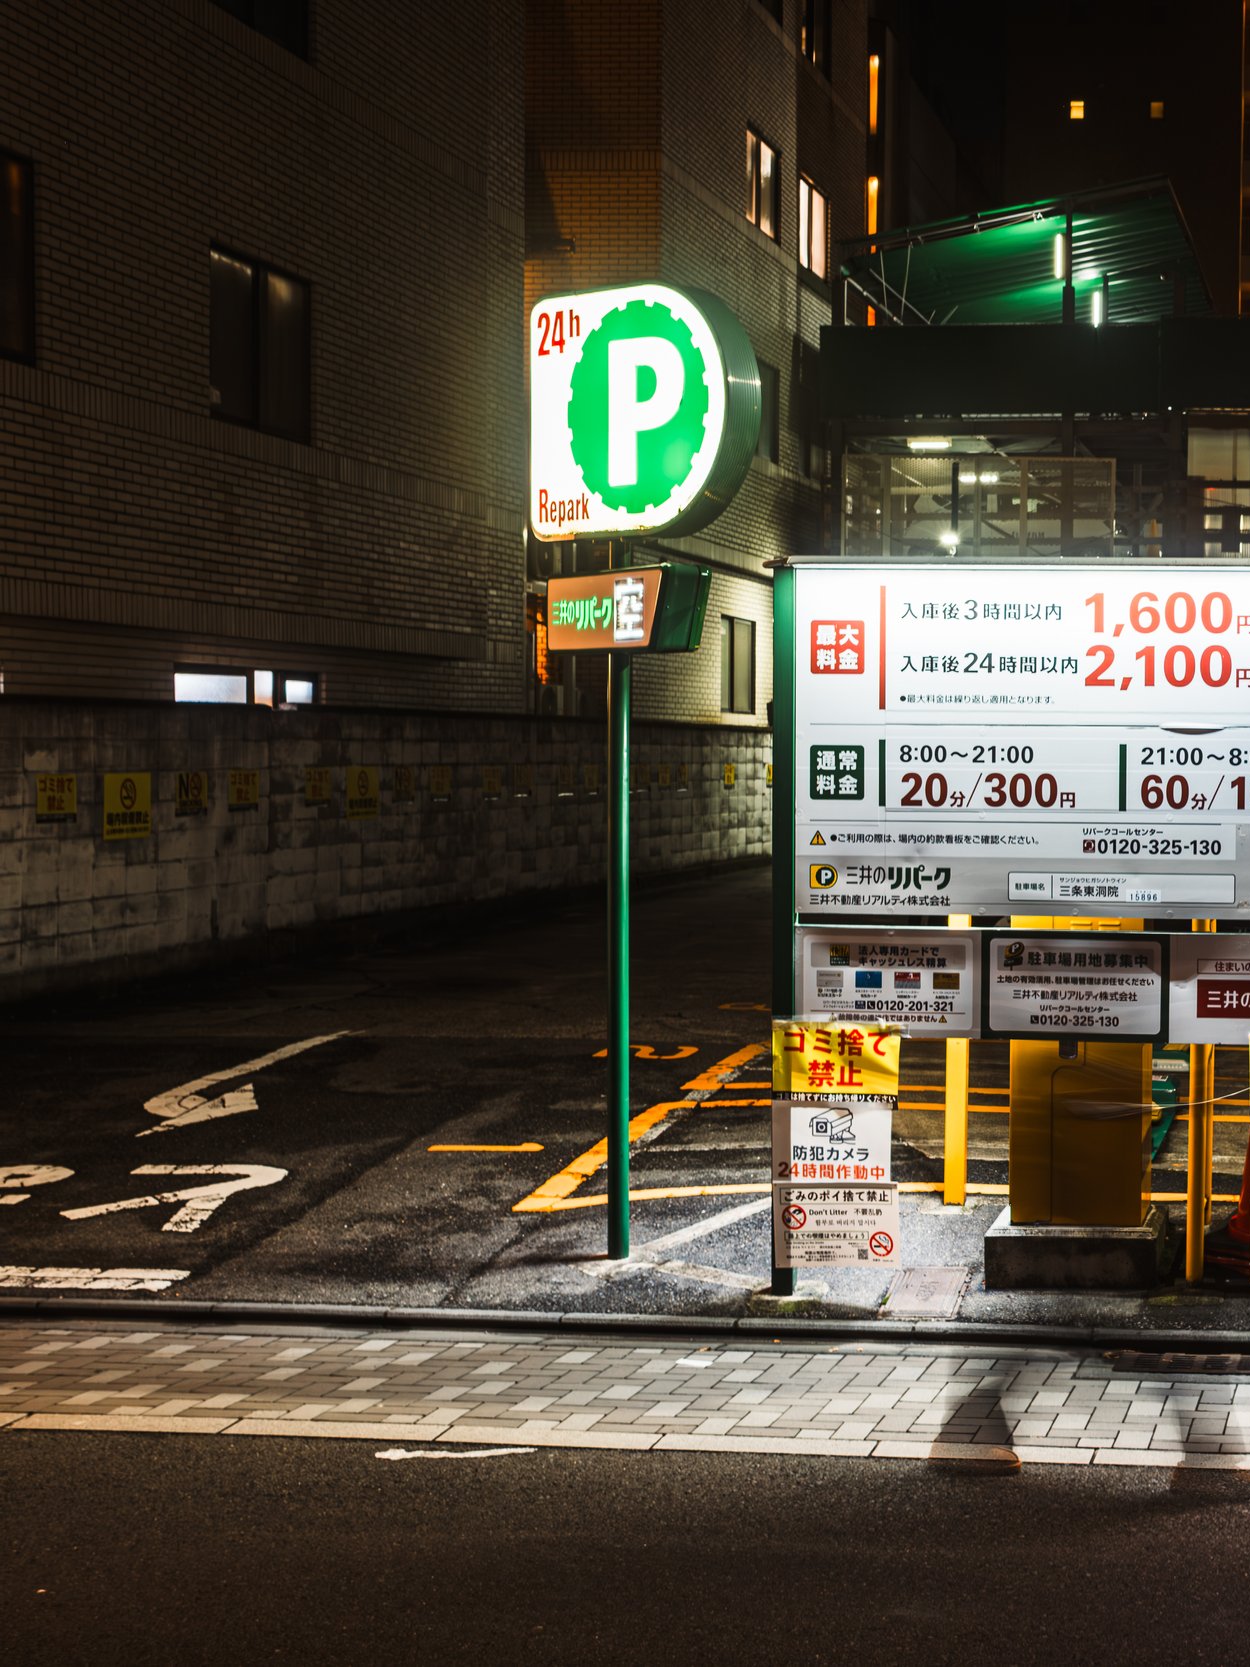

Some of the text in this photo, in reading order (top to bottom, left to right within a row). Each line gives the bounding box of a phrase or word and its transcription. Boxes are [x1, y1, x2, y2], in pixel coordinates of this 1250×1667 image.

[537, 309, 581, 356] 24h
[607, 336, 685, 488] P
[538, 488, 590, 528] Repark
[551, 597, 613, 629] 三井のリパーク
[900, 599, 1063, 621] 入庫後3時間以内
[816, 624, 860, 647] 最大
[816, 648, 860, 671] 料金
[900, 652, 1079, 675] 入庫後24時間以内
[815, 750, 859, 771] 通常
[815, 774, 859, 796] 料金
[1082, 827, 1164, 836] リパークコールセンター
[1097, 839, 1222, 856] 0120-325-130
[845, 863, 952, 891] 三井のリパーク
[1014, 882, 1046, 892] 駐車場名
[1058, 884, 1120, 899] 三条東洞院
[809, 893, 951, 908] 三井不動産リアルティ株式会社
[1129, 892, 1159, 902] 15896
[858, 956, 948, 969] キャッシュレス精算
[1027, 951, 1149, 969] 駐車場用地募集中
[1012, 988, 1139, 1003] 三井不動産リアルティ株式会社
[876, 1000, 954, 1012] 0120-201-321
[1039, 1004, 1111, 1013] リパークコールセンター
[1040, 1014, 1120, 1029] 0120-325-130
[783, 1026, 890, 1058] ゴミ捨て
[808, 1059, 864, 1088] 禁止
[792, 1145, 870, 1162] 防犯カメラ
[777, 1161, 885, 1181] 24時間作動中
[784, 1189, 890, 1203] ごみのポイ捨て禁止
[808, 1208, 848, 1217] Don't Litter
